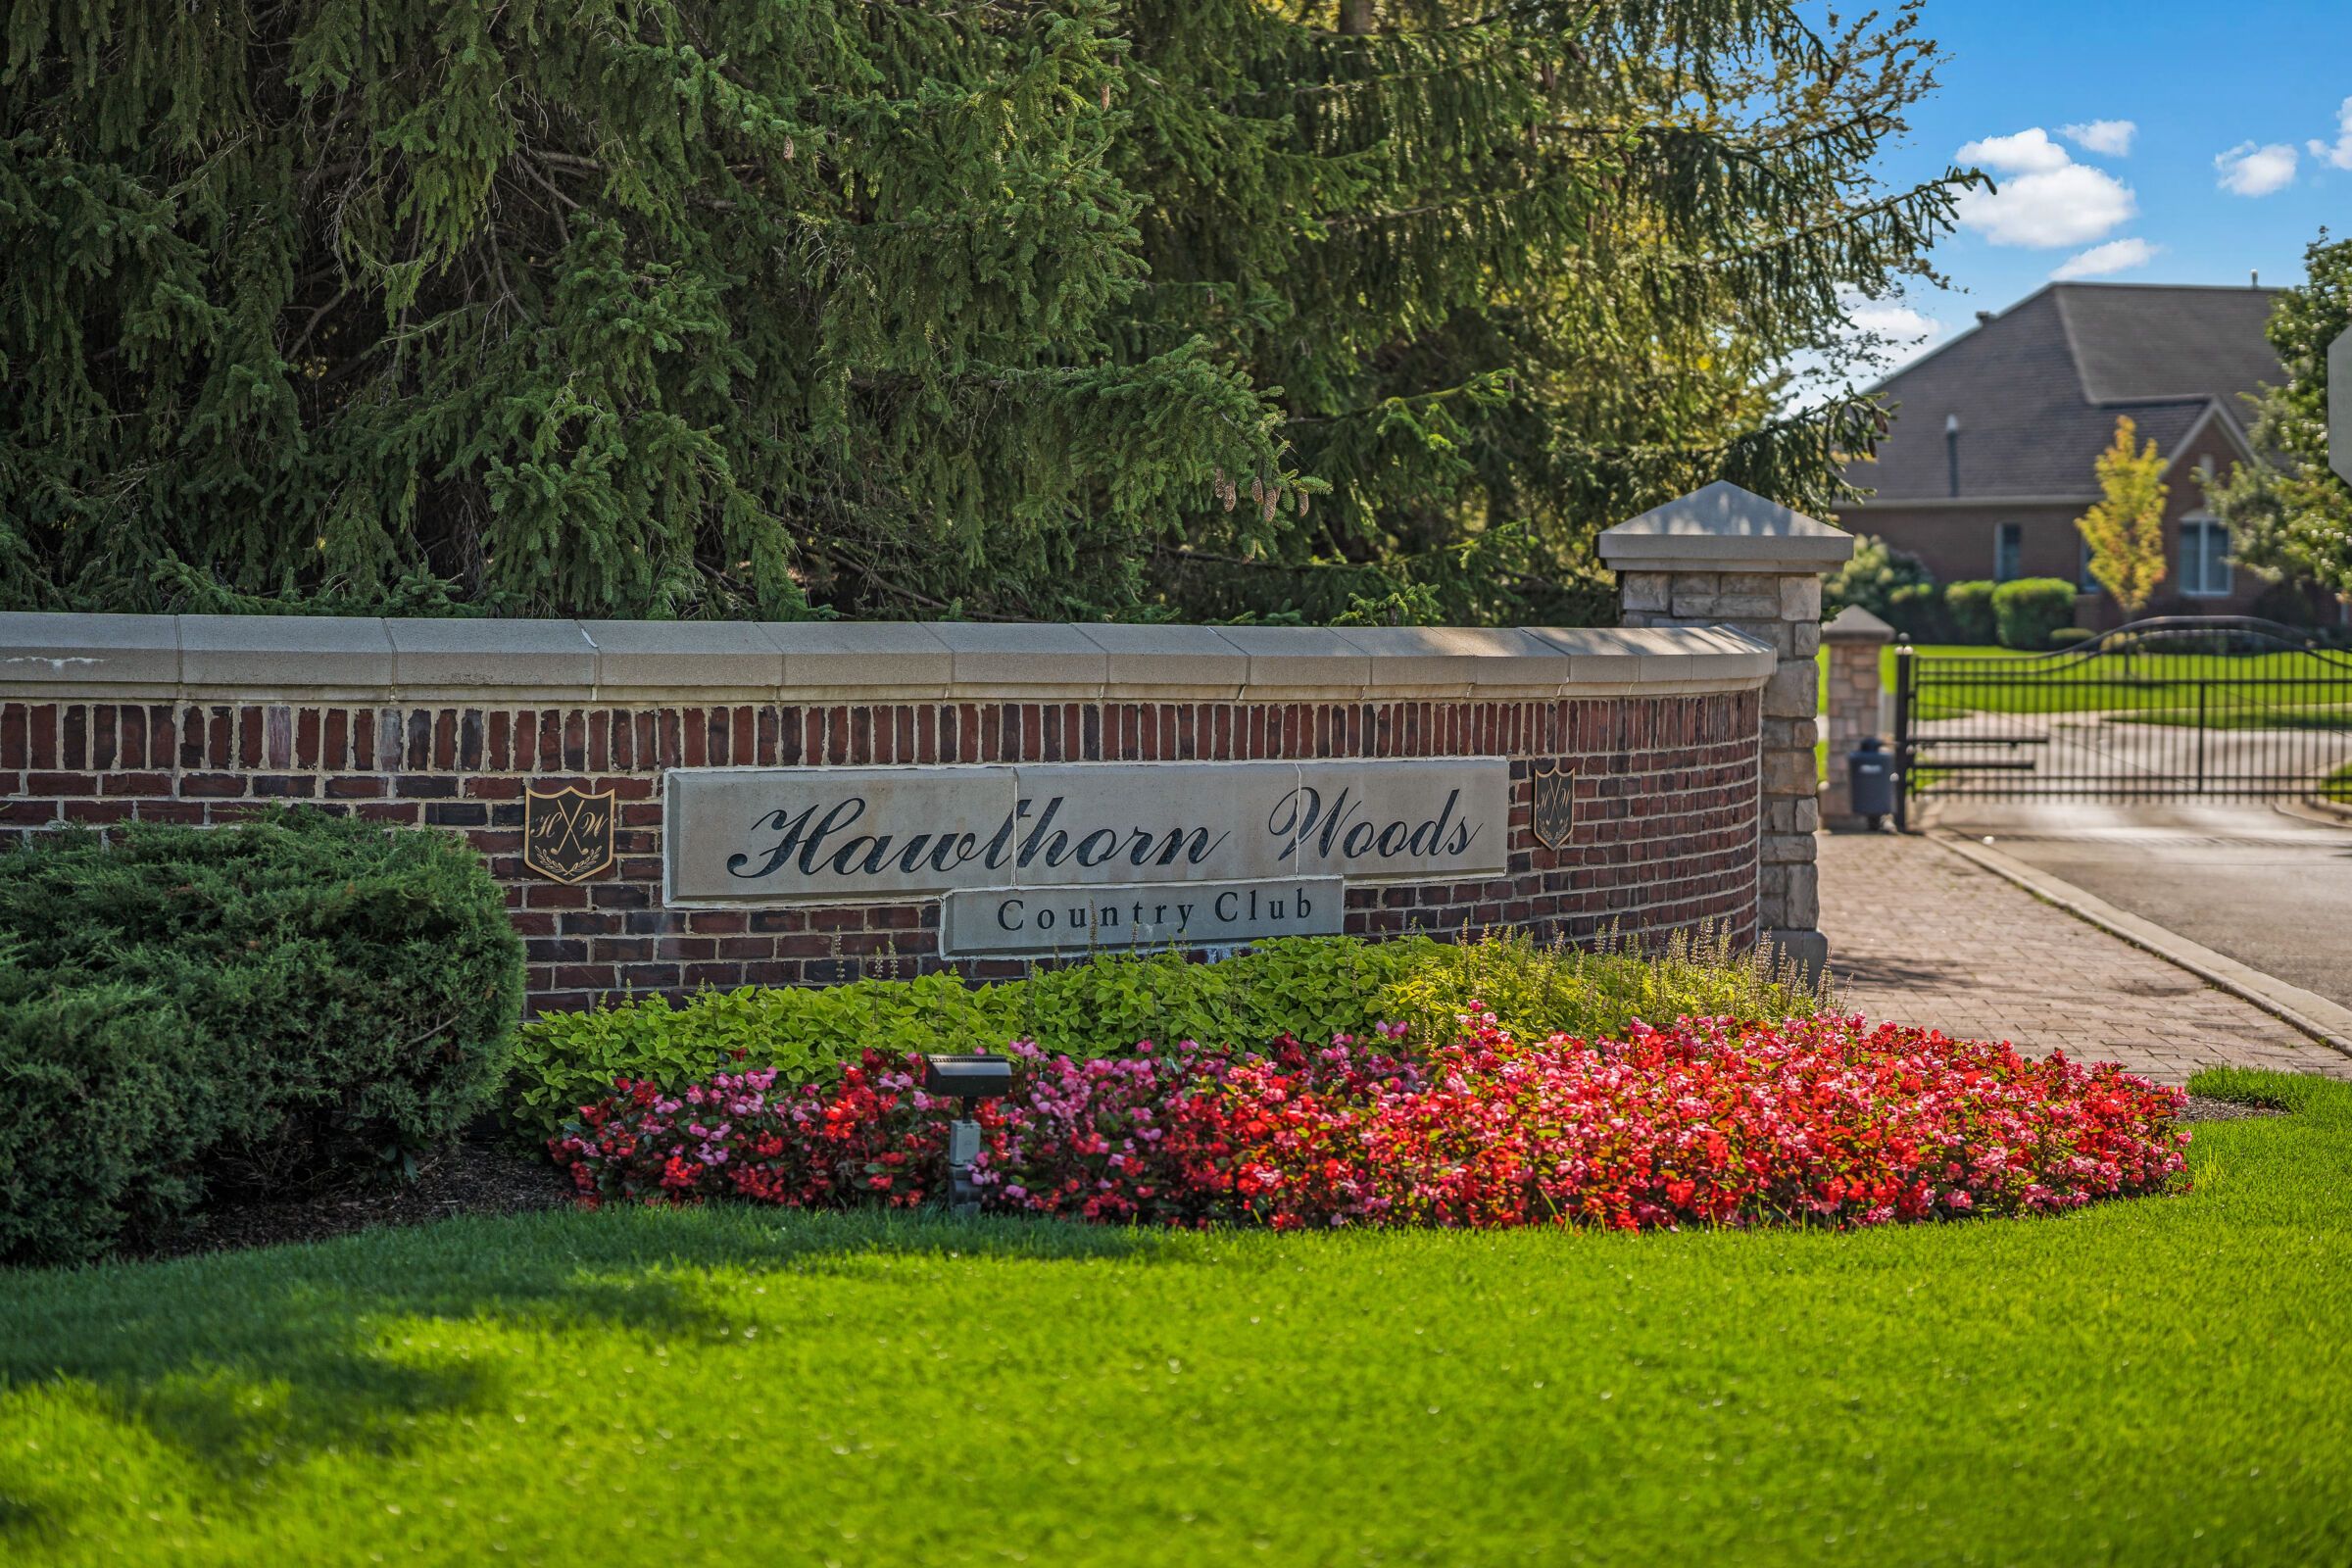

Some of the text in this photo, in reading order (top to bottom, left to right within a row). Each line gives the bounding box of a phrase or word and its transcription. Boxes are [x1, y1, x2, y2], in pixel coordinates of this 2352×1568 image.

[728, 786, 1484, 878] Hawthorn Woods
[997, 887, 1312, 932] Country Club
